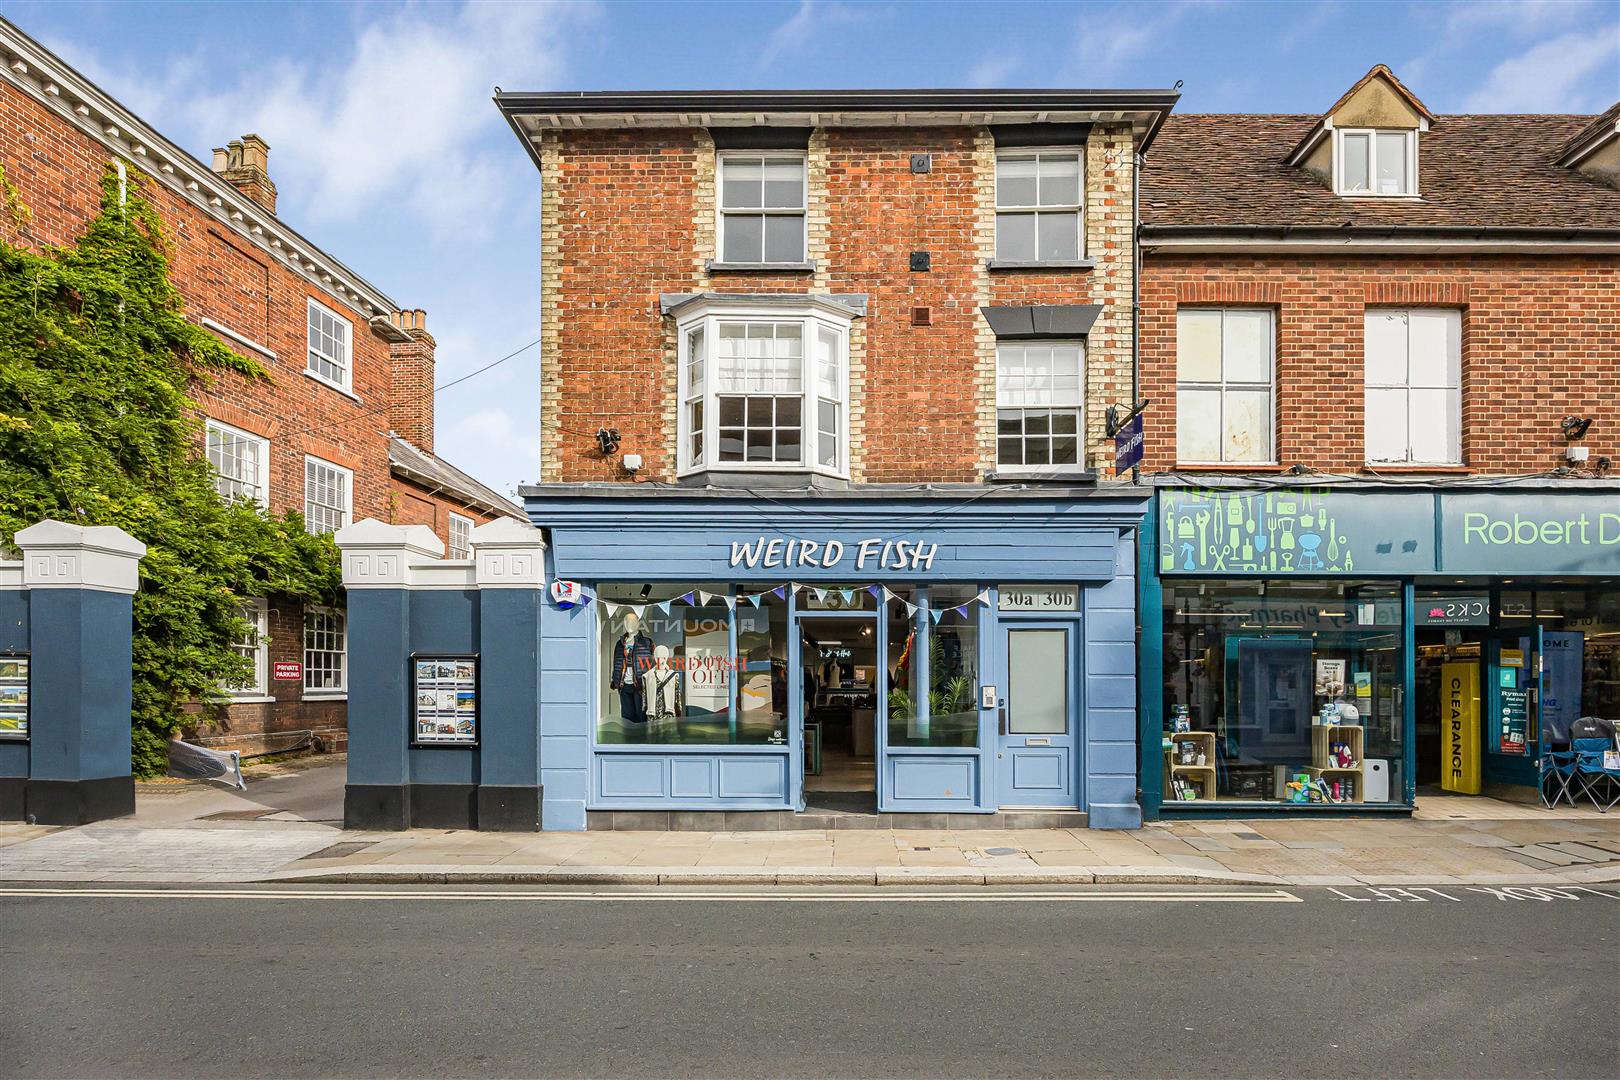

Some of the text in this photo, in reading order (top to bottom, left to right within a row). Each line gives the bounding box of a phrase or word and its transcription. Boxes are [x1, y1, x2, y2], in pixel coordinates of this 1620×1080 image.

[1464, 512, 1590, 544] Robert
[730, 536, 938, 569] WEIRD FISH
[1006, 591, 1073, 606] 30a 30b
[692, 670, 729, 684] OFF
[1451, 678, 1462, 778] CLEARANCE
[1326, 887, 1462, 902] LEFT
